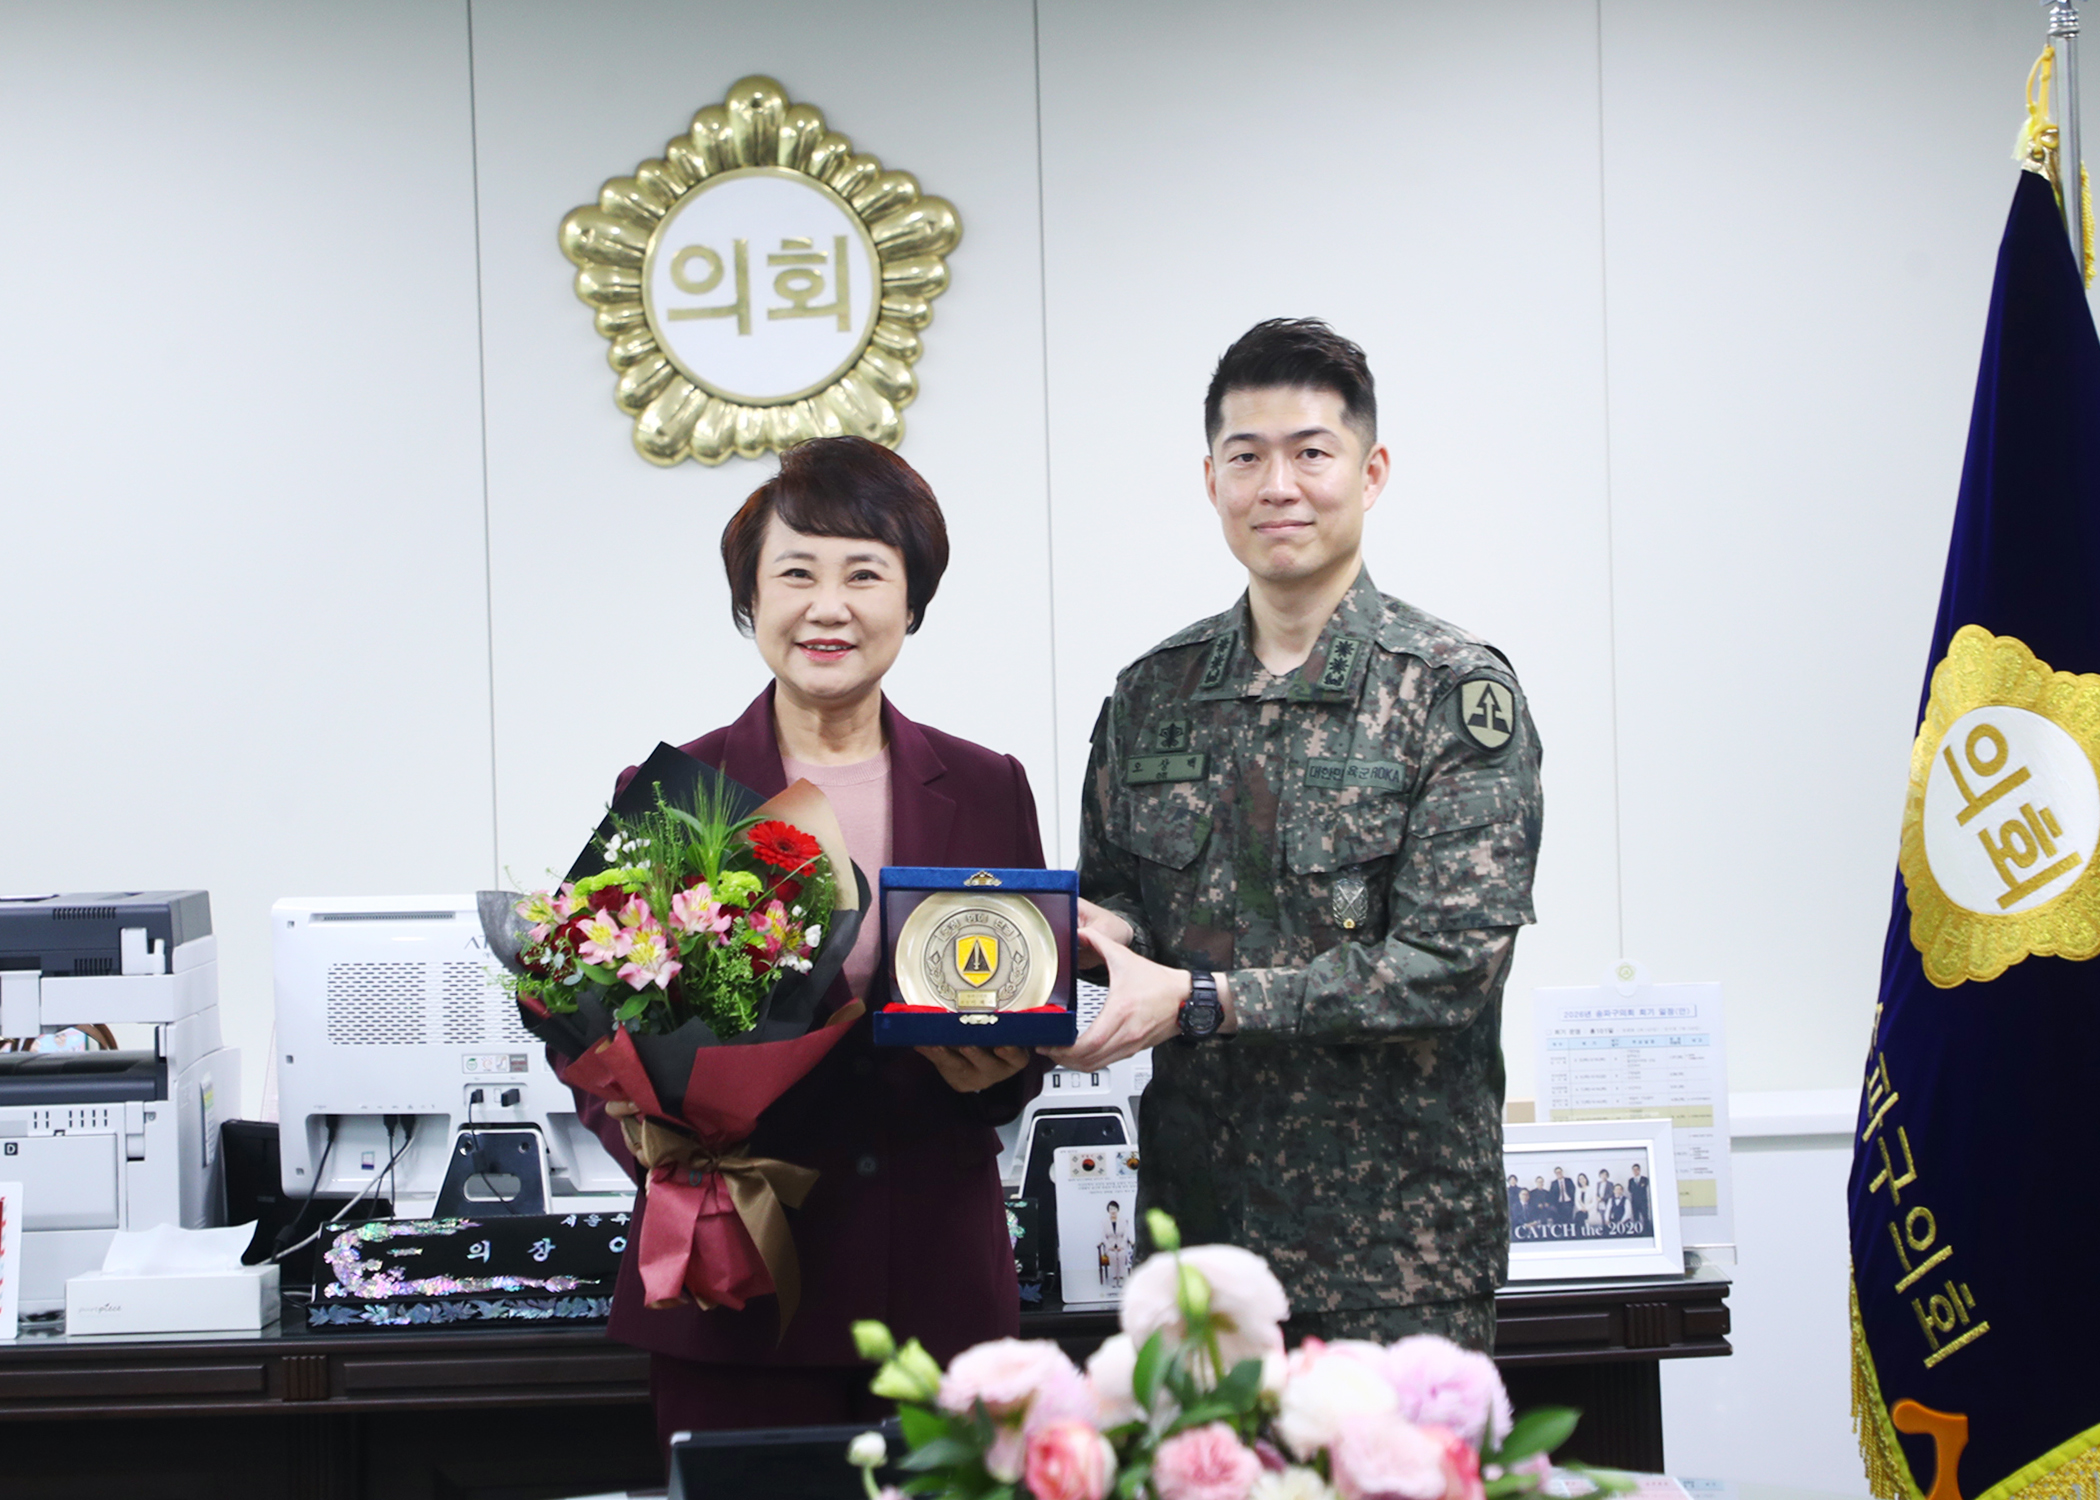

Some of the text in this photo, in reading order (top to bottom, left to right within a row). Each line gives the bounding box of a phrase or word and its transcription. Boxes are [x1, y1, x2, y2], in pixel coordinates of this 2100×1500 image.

[667, 235, 852, 336] 의회
[1943, 723, 2083, 910] 의회
[1514, 1221, 1643, 1239] CATCH the 2020
[1862, 1002, 1991, 1370] 파구의회
